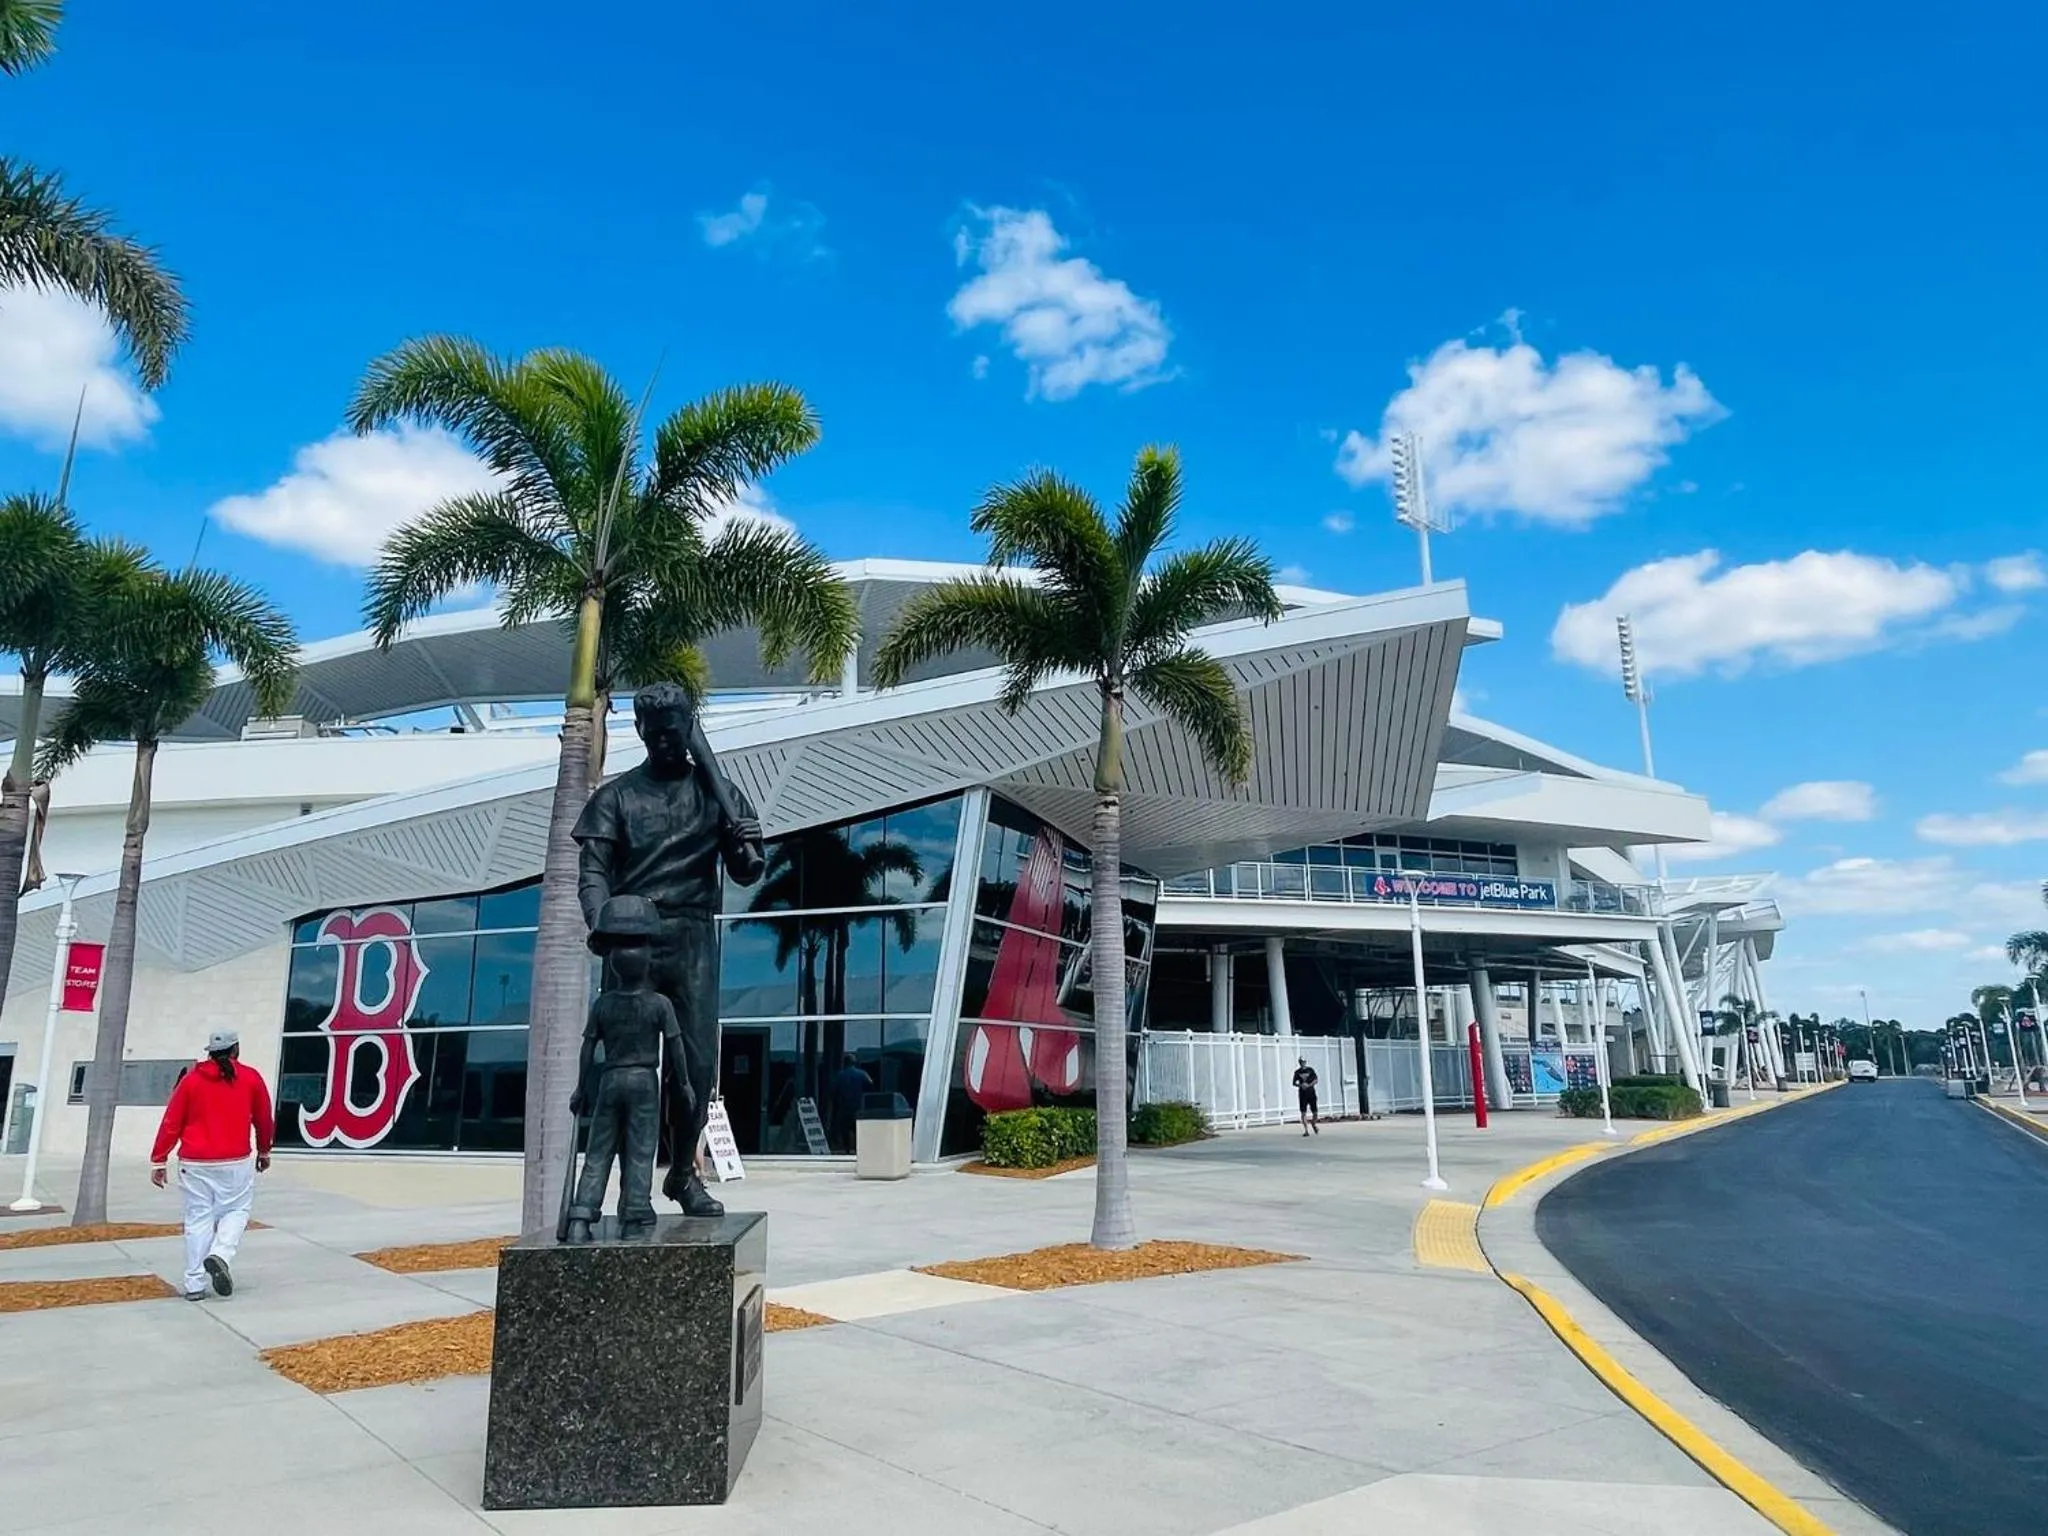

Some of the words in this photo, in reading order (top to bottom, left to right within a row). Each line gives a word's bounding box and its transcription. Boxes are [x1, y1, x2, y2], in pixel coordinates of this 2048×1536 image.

[1458, 883, 1477, 897] TO
[1480, 882, 1519, 900] jetBlue
[1520, 884, 1547, 900] Park
[70, 965, 97, 975] TEAM
[66, 979, 97, 989] STORE
[298, 905, 430, 1149] B
[713, 1136, 731, 1145] OPEN
[715, 1148, 736, 1158] TODAY
